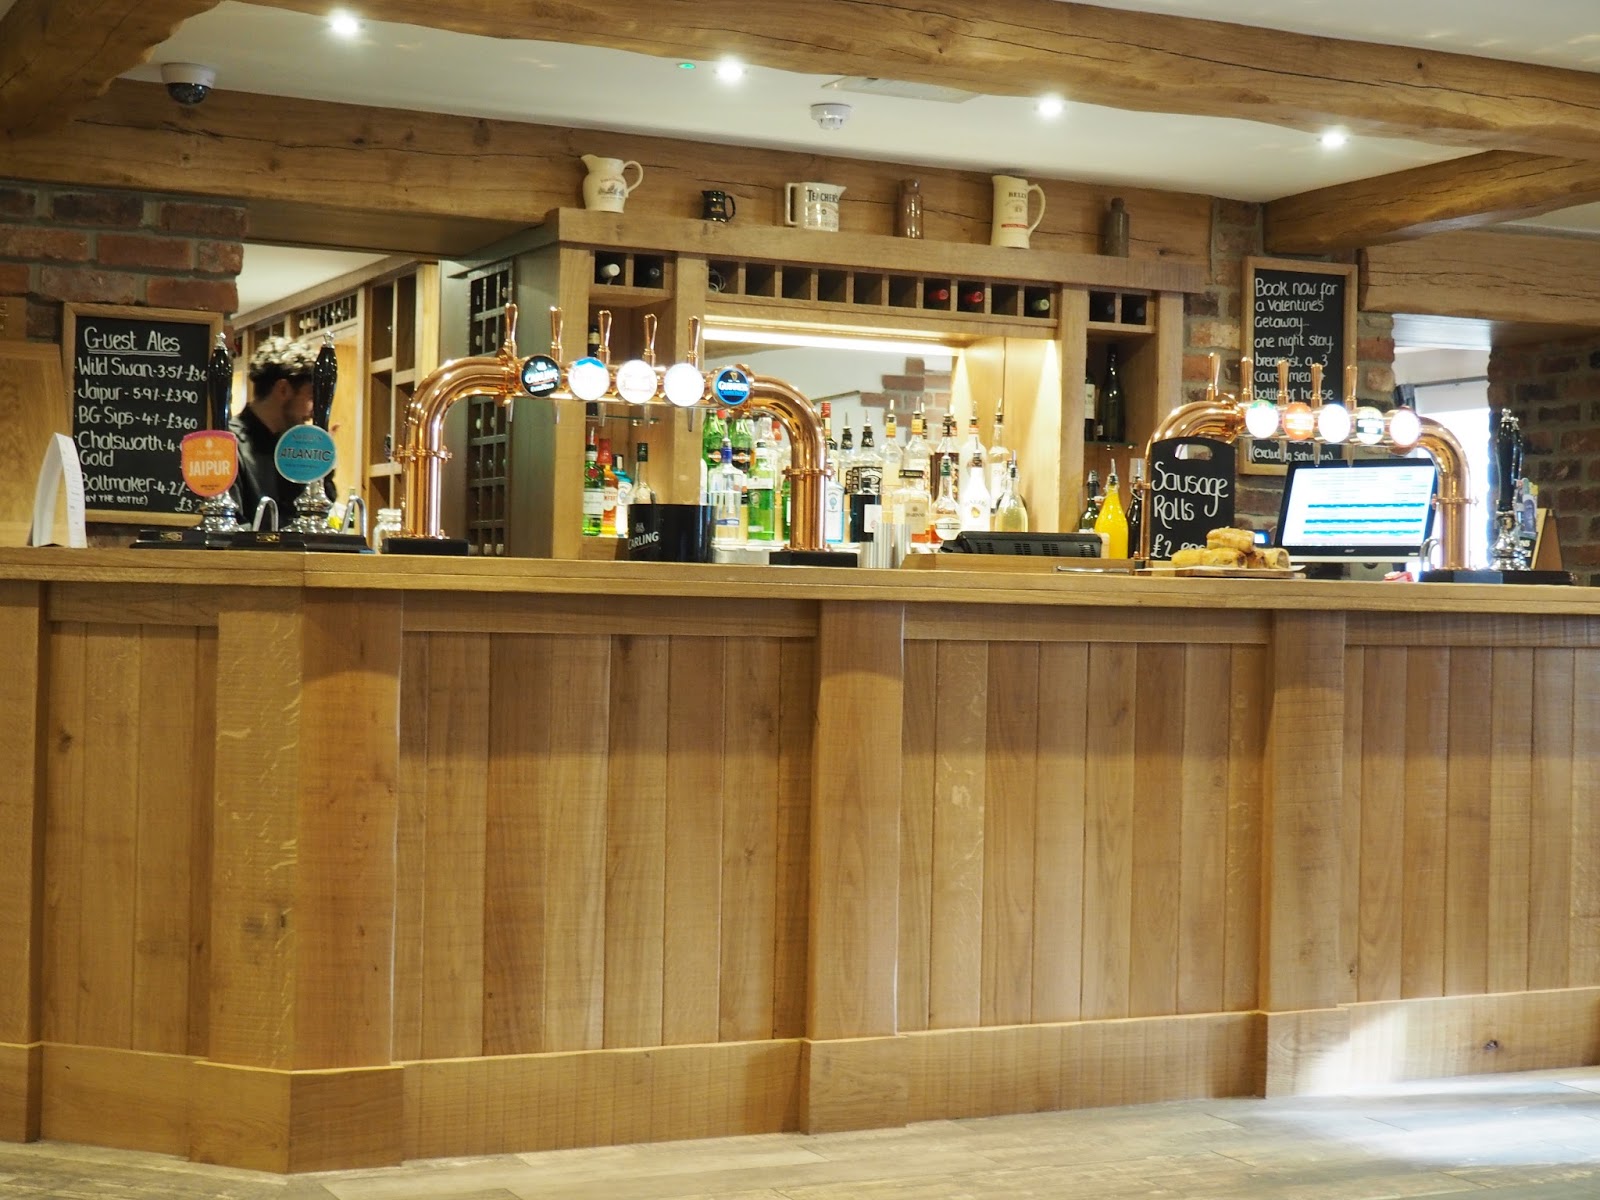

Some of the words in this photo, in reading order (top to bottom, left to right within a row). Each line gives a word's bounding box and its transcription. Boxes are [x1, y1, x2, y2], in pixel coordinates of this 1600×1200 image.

[1255, 278, 1289, 297] Book
[1292, 282, 1317, 295] now
[1319, 283, 1338, 300] for
[1255, 301, 1264, 312] a
[84, 326, 137, 350] Guest
[146, 330, 180, 351] Ales
[1254, 337, 1274, 348] one
[1278, 335, 1304, 356] night
[78, 356, 108, 376] Wild
[1322, 355, 1329, 367] 3
[77, 379, 122, 404] Jaipur
[1301, 387, 1334, 400] hose
[78, 405, 102, 424] BG
[103, 406, 134, 429] Sips
[80, 449, 114, 467] Gold
[280, 447, 332, 462] ATLANTIC
[189, 459, 231, 476] JAIPUR
[1151, 461, 1230, 518] Sausage
[1153, 494, 1195, 530] Rolls
[627, 531, 660, 550] CARLING
